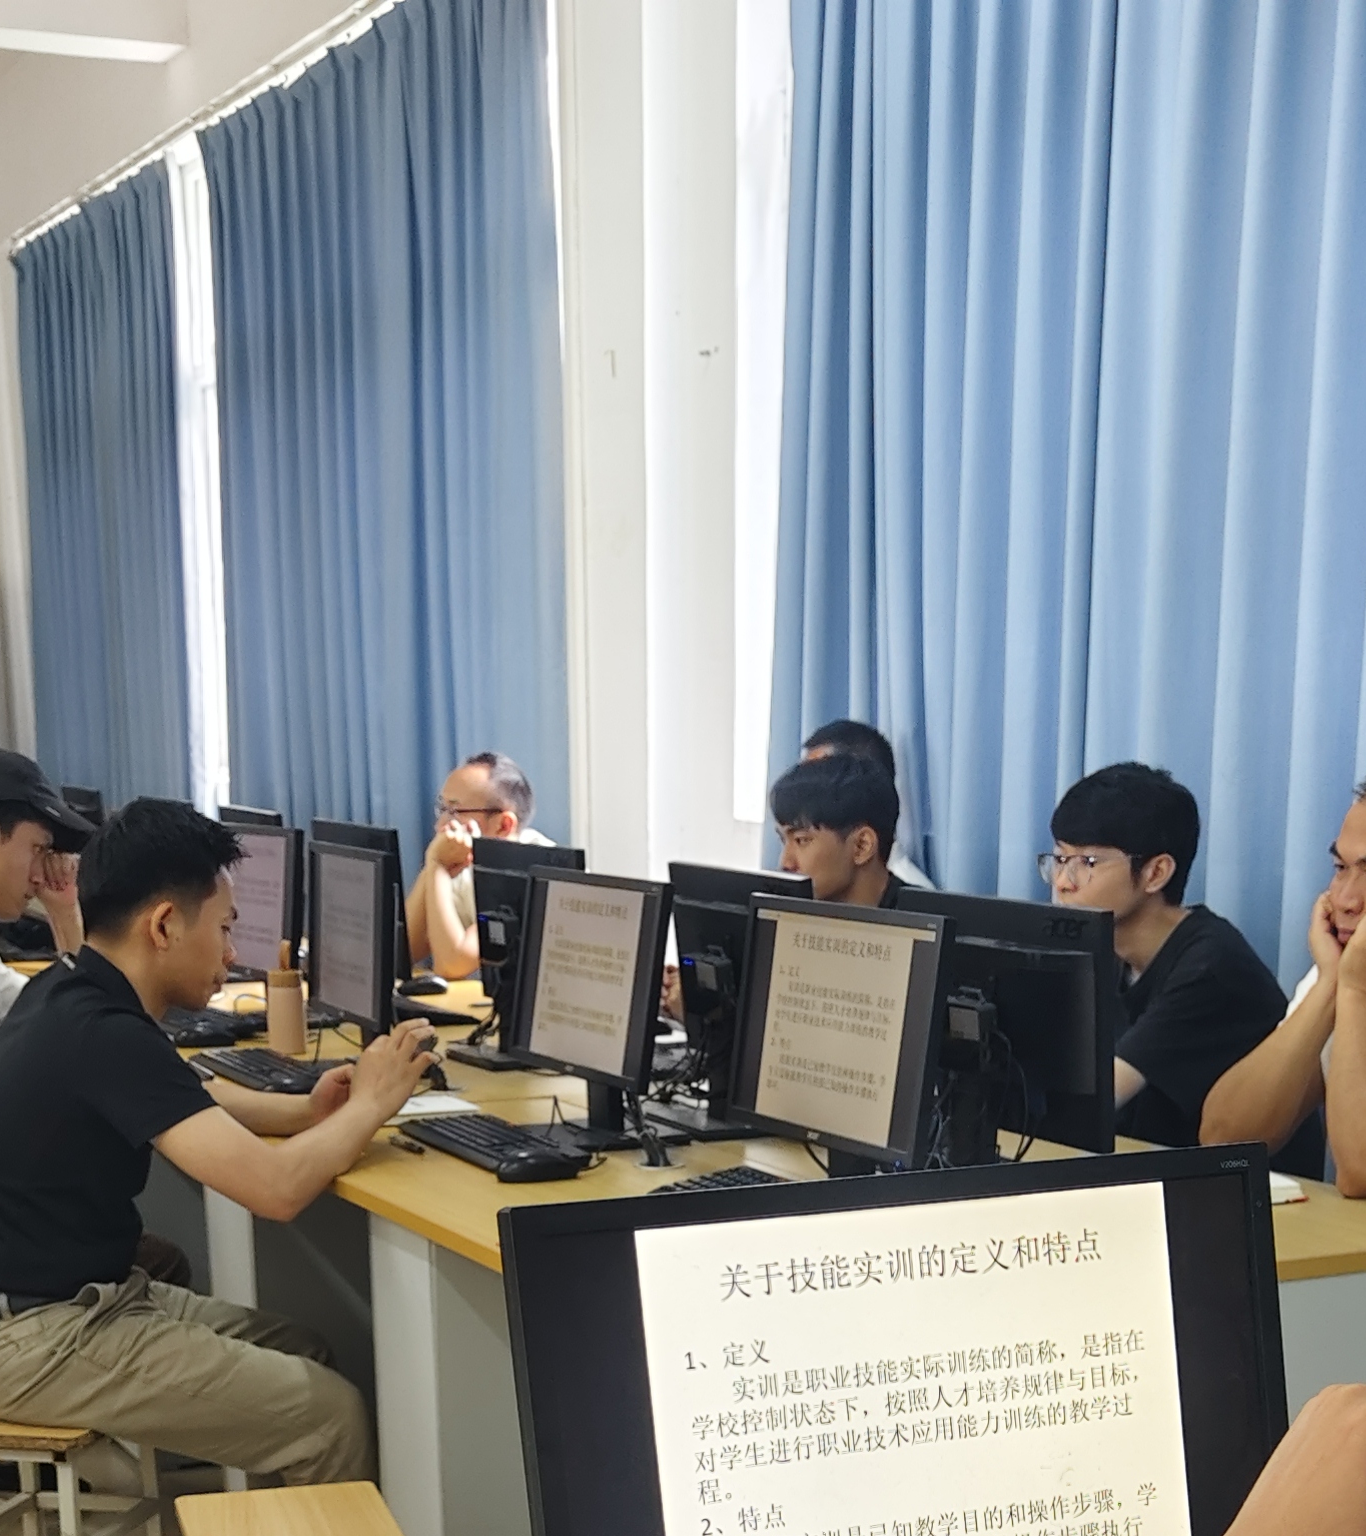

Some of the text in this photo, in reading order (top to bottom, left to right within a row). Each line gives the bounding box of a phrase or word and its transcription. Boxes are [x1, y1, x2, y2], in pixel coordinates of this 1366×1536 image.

[720, 1228, 1102, 1302] 关于技能实训的定义和特点
[685, 1339, 770, 1371] 1、定义
[732, 1329, 1144, 1402] 实训是职业技能实际训练的简称，是指在
[692, 1362, 1139, 1441] 学校控制状态下，按照人才培养规律与目标，
[695, 1393, 1133, 1474] 对学生进行职业技术应用能力训练的教学过
[698, 1479, 732, 1505] 程。
[701, 1503, 786, 1536] 2、特点
